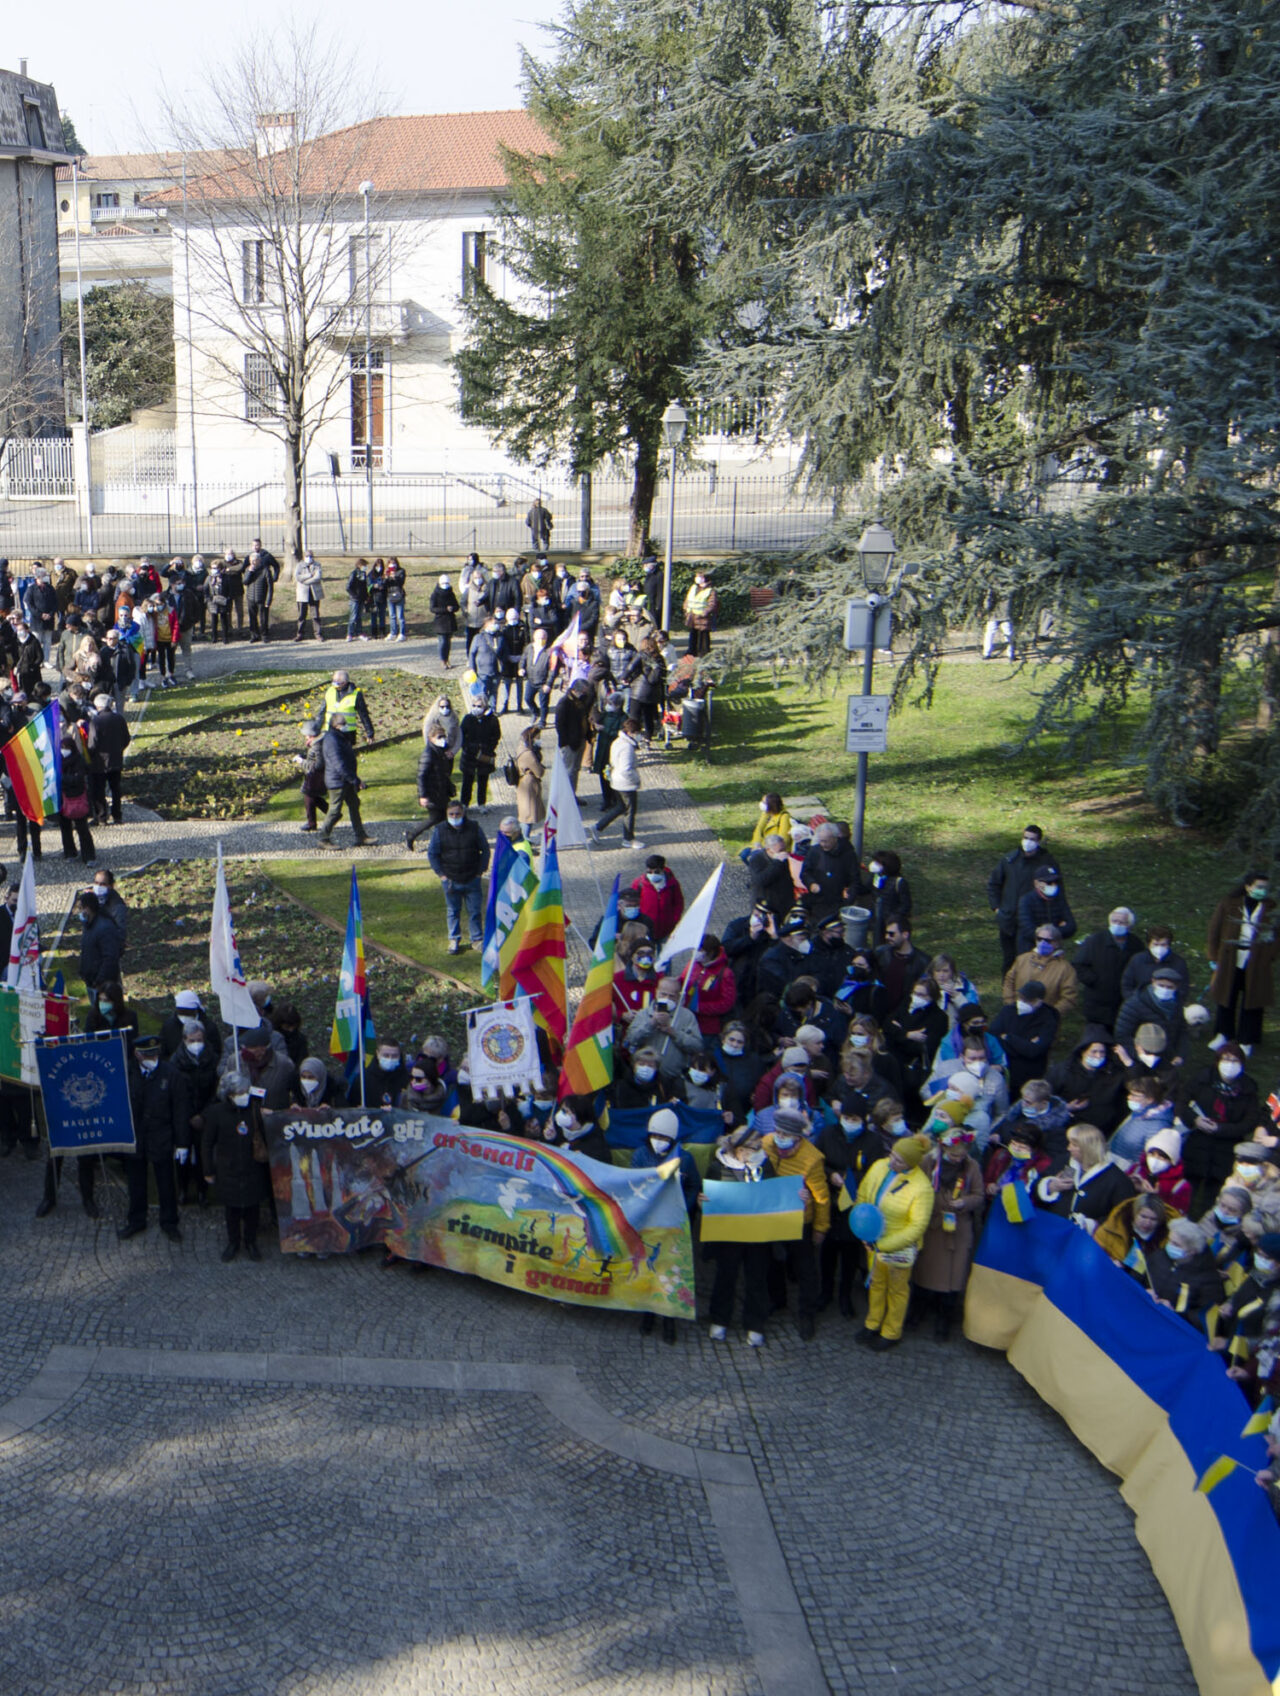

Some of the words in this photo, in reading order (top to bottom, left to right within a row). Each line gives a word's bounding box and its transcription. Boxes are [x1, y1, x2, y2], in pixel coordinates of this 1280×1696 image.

[48, 1053, 74, 1080] BANDA
[82, 1050, 116, 1074] CIVICA
[62, 1116, 114, 1128] MAGENTA
[283, 1115, 385, 1141] svuotate
[393, 1120, 425, 1142] gli
[432, 1131, 538, 1173] arsenali
[447, 1215, 554, 1260] riempite
[505, 1254, 517, 1273] i
[525, 1269, 614, 1296] granai
